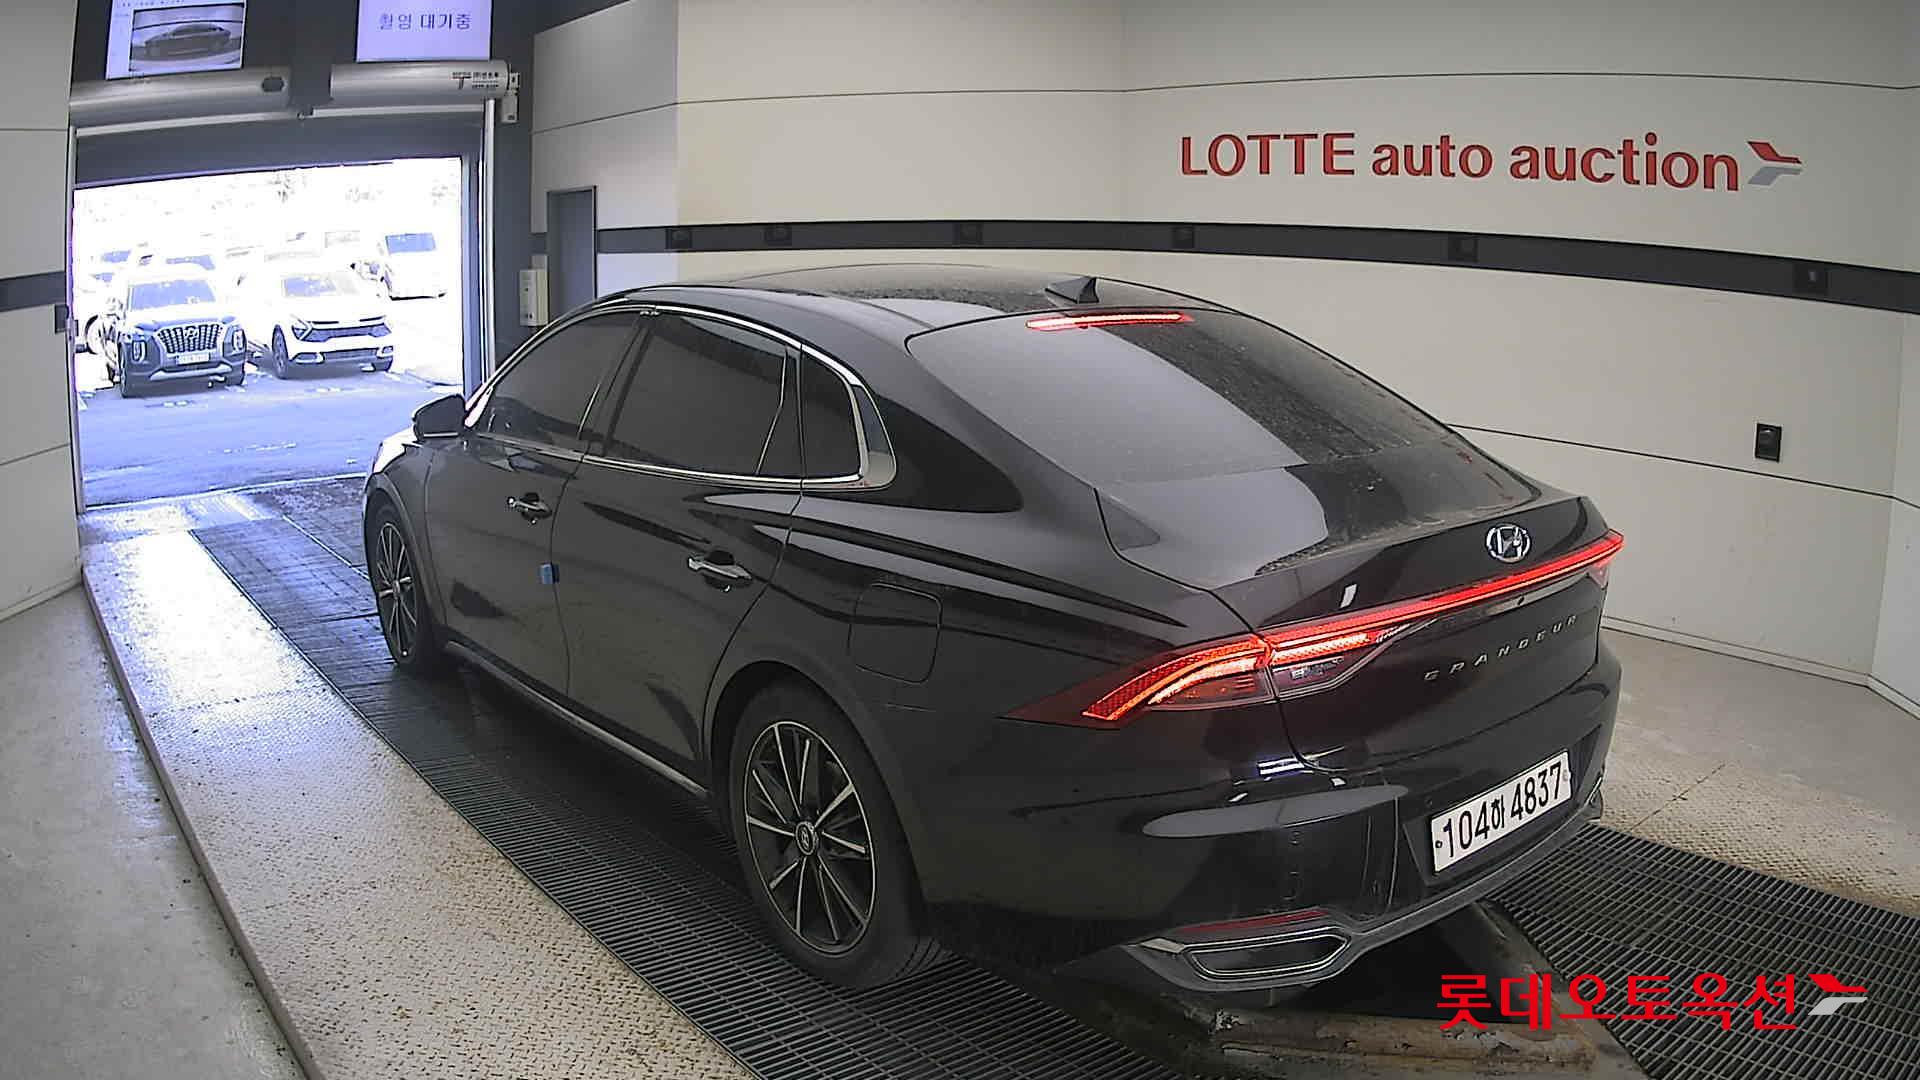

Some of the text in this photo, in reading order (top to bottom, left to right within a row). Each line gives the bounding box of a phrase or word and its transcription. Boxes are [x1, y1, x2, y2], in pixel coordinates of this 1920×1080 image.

[420, 13, 472, 31] 대기중
[1180, 132, 1739, 191] LOTTE auto auction
[1424, 614, 1576, 681] GRANDEUR
[1510, 760, 1562, 821] 4837
